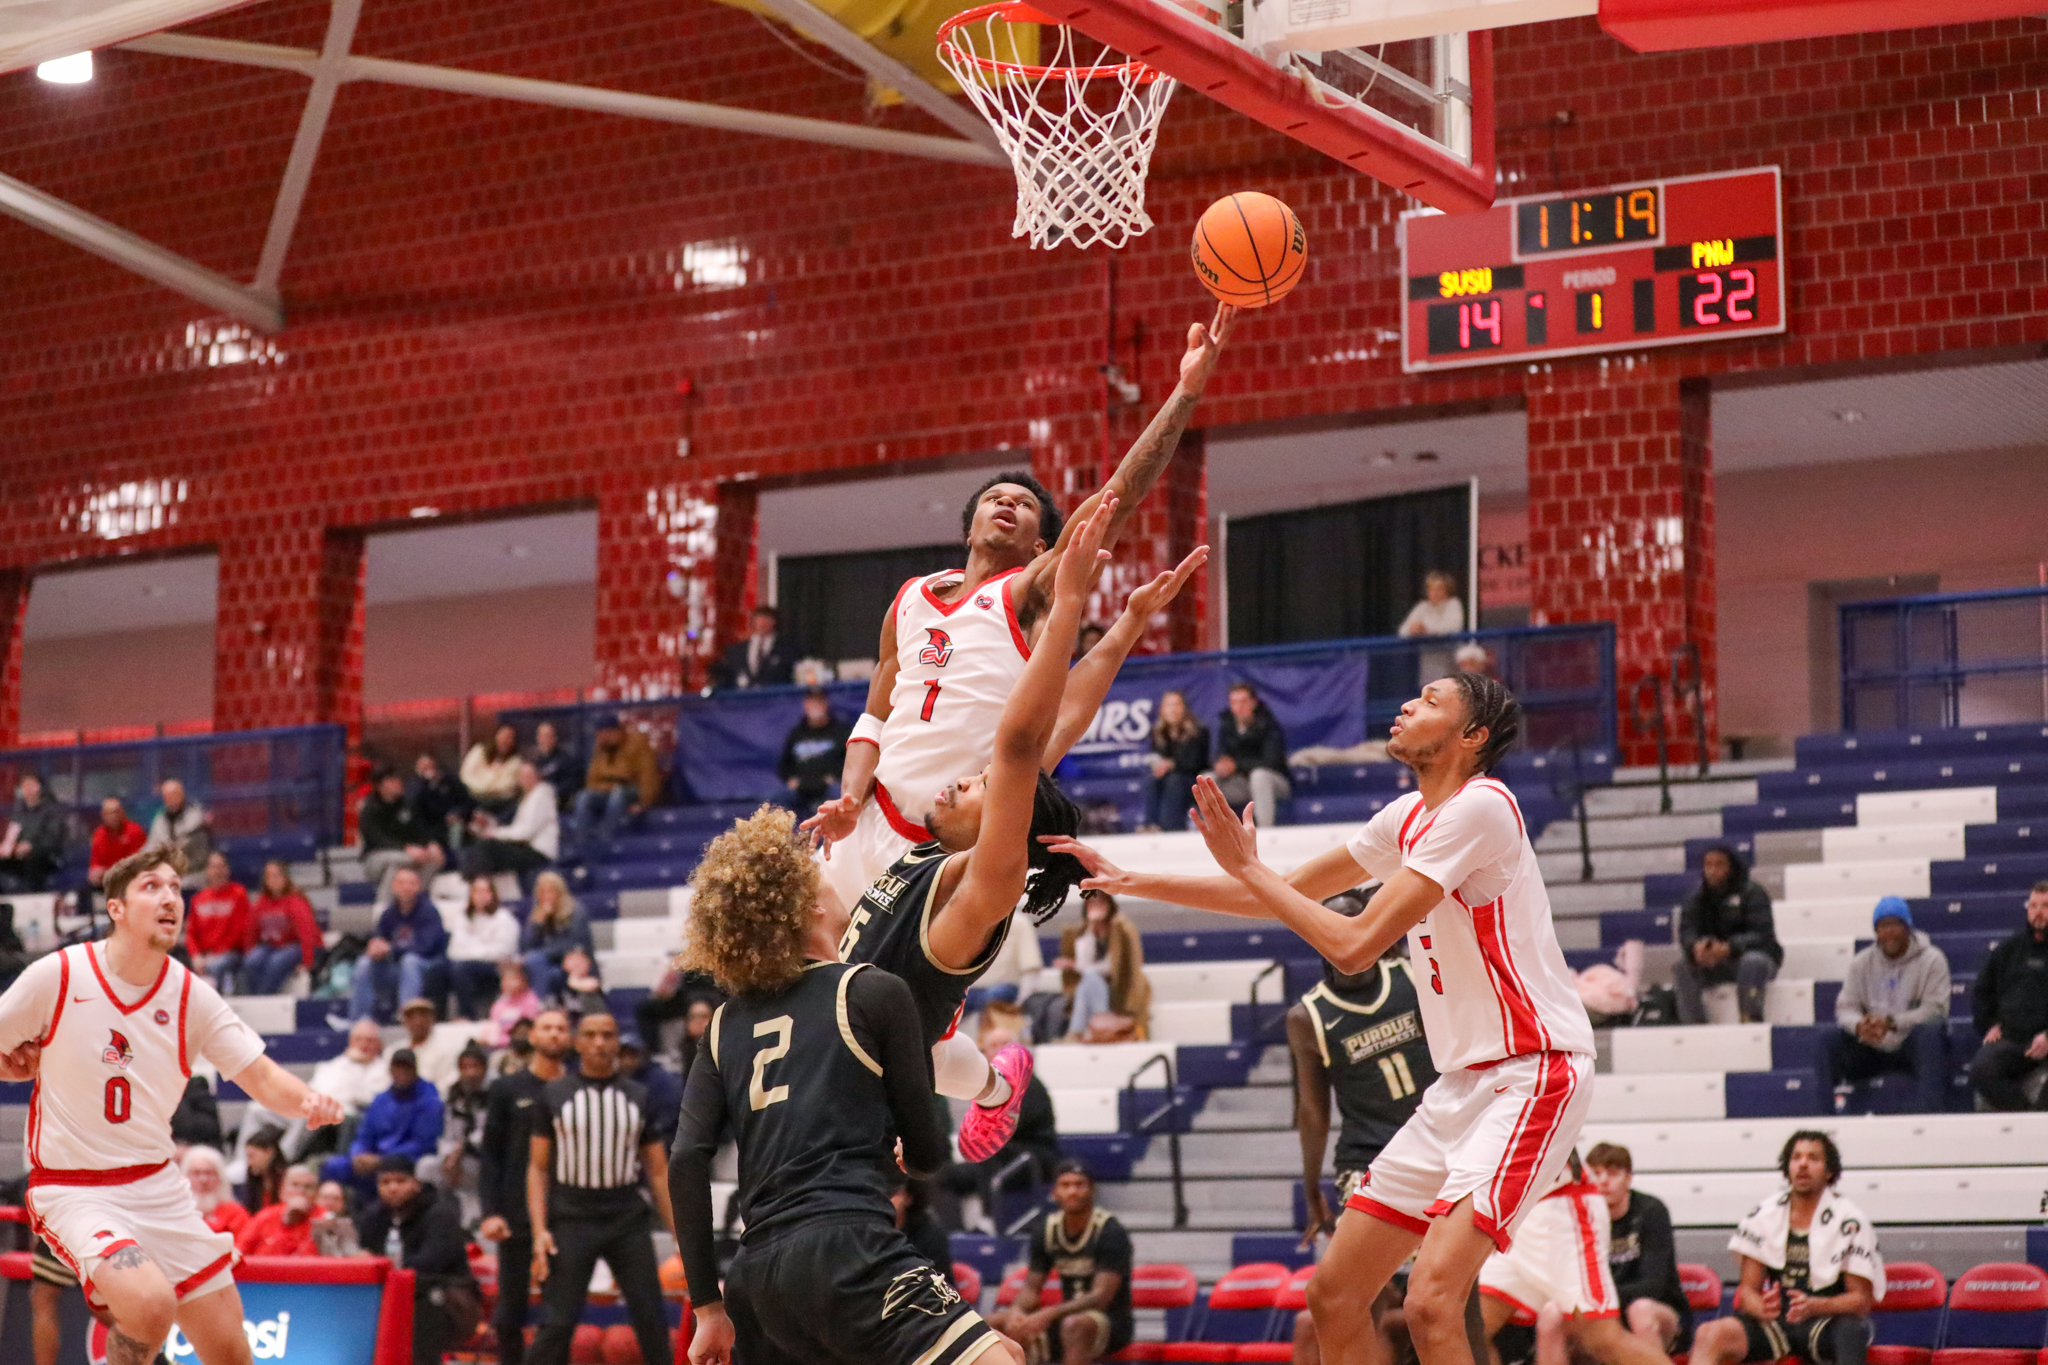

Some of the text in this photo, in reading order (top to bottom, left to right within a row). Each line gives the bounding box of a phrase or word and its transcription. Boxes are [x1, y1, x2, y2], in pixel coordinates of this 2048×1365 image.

[1539, 190, 1656, 249] 11:19
[1692, 238, 1734, 269] PNW
[1590, 293, 1603, 329] 1
[1693, 269, 1755, 325] 22
[1459, 301, 1501, 348] 14
[920, 678, 942, 722] 1
[1346, 1015, 1416, 1053] PURDUE
[1352, 1027, 1418, 1061] NORTHWEST
[749, 1014, 794, 1112] 2
[1378, 1052, 1417, 1101] 11
[104, 1076, 131, 1125] 0
[164, 1311, 291, 1365] psi
